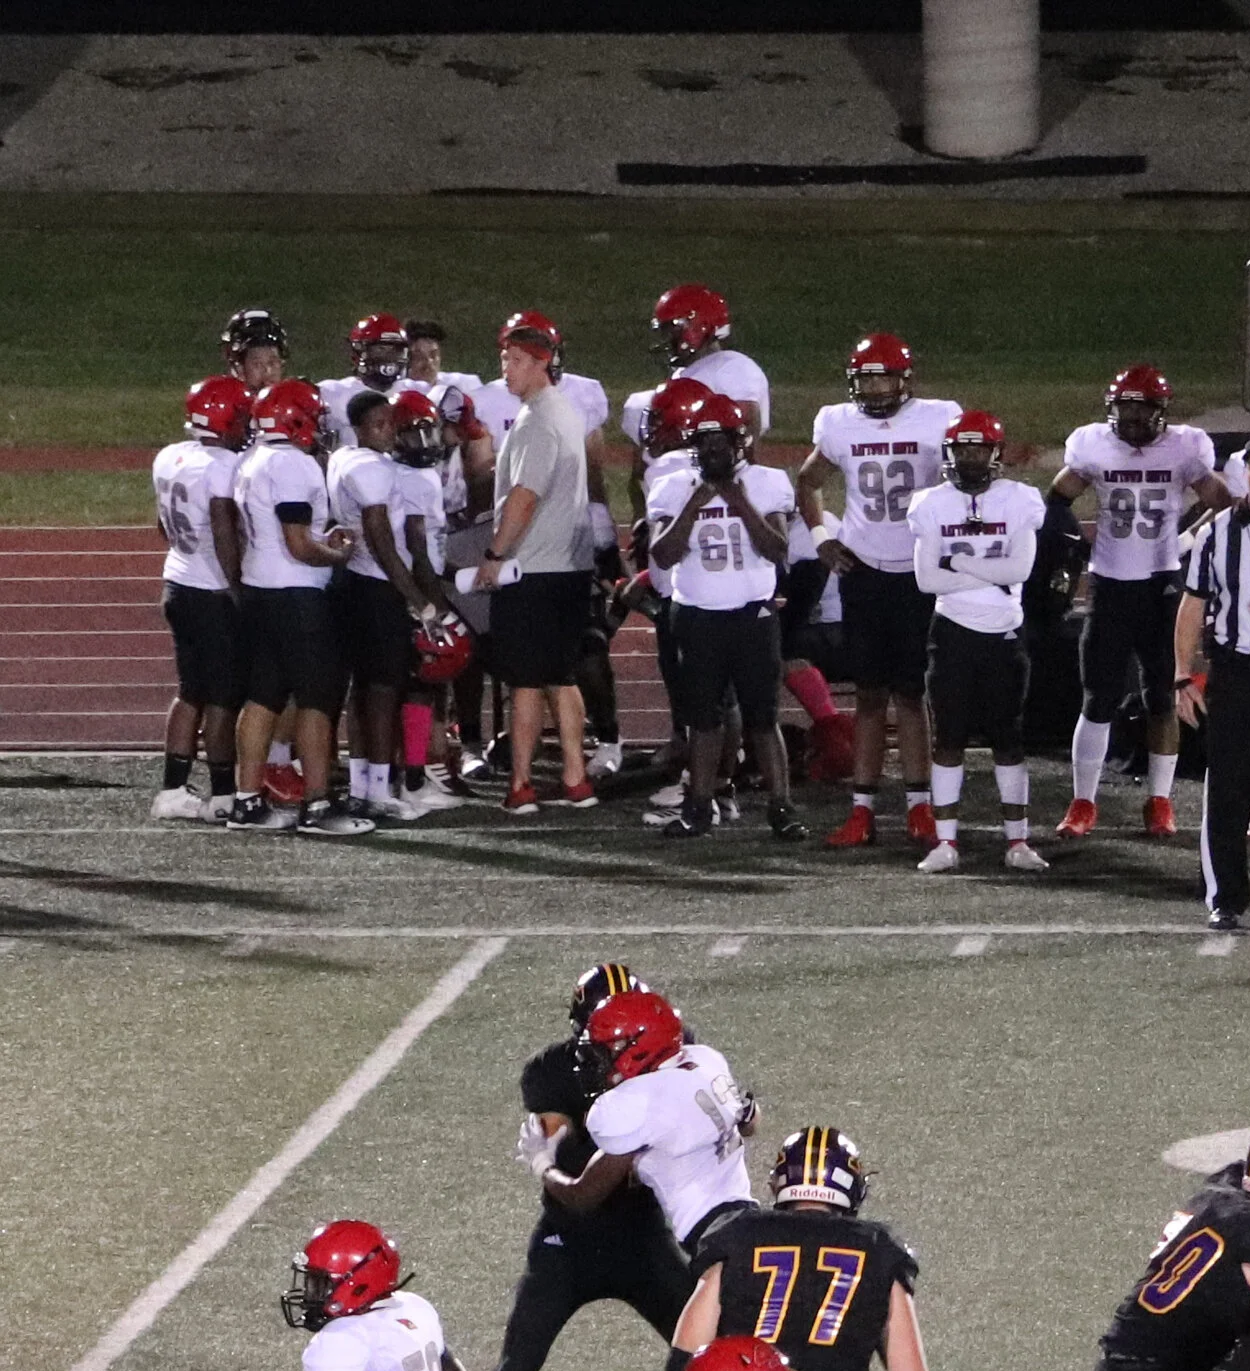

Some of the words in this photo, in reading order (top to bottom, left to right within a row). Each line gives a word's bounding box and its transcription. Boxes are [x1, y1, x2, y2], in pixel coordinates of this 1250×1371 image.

[858, 461, 916, 522] 92
[1110, 488, 1167, 539] 95
[698, 523, 744, 572] 61
[790, 1188, 836, 1201] Riddell
[753, 1246, 866, 1346] 77
